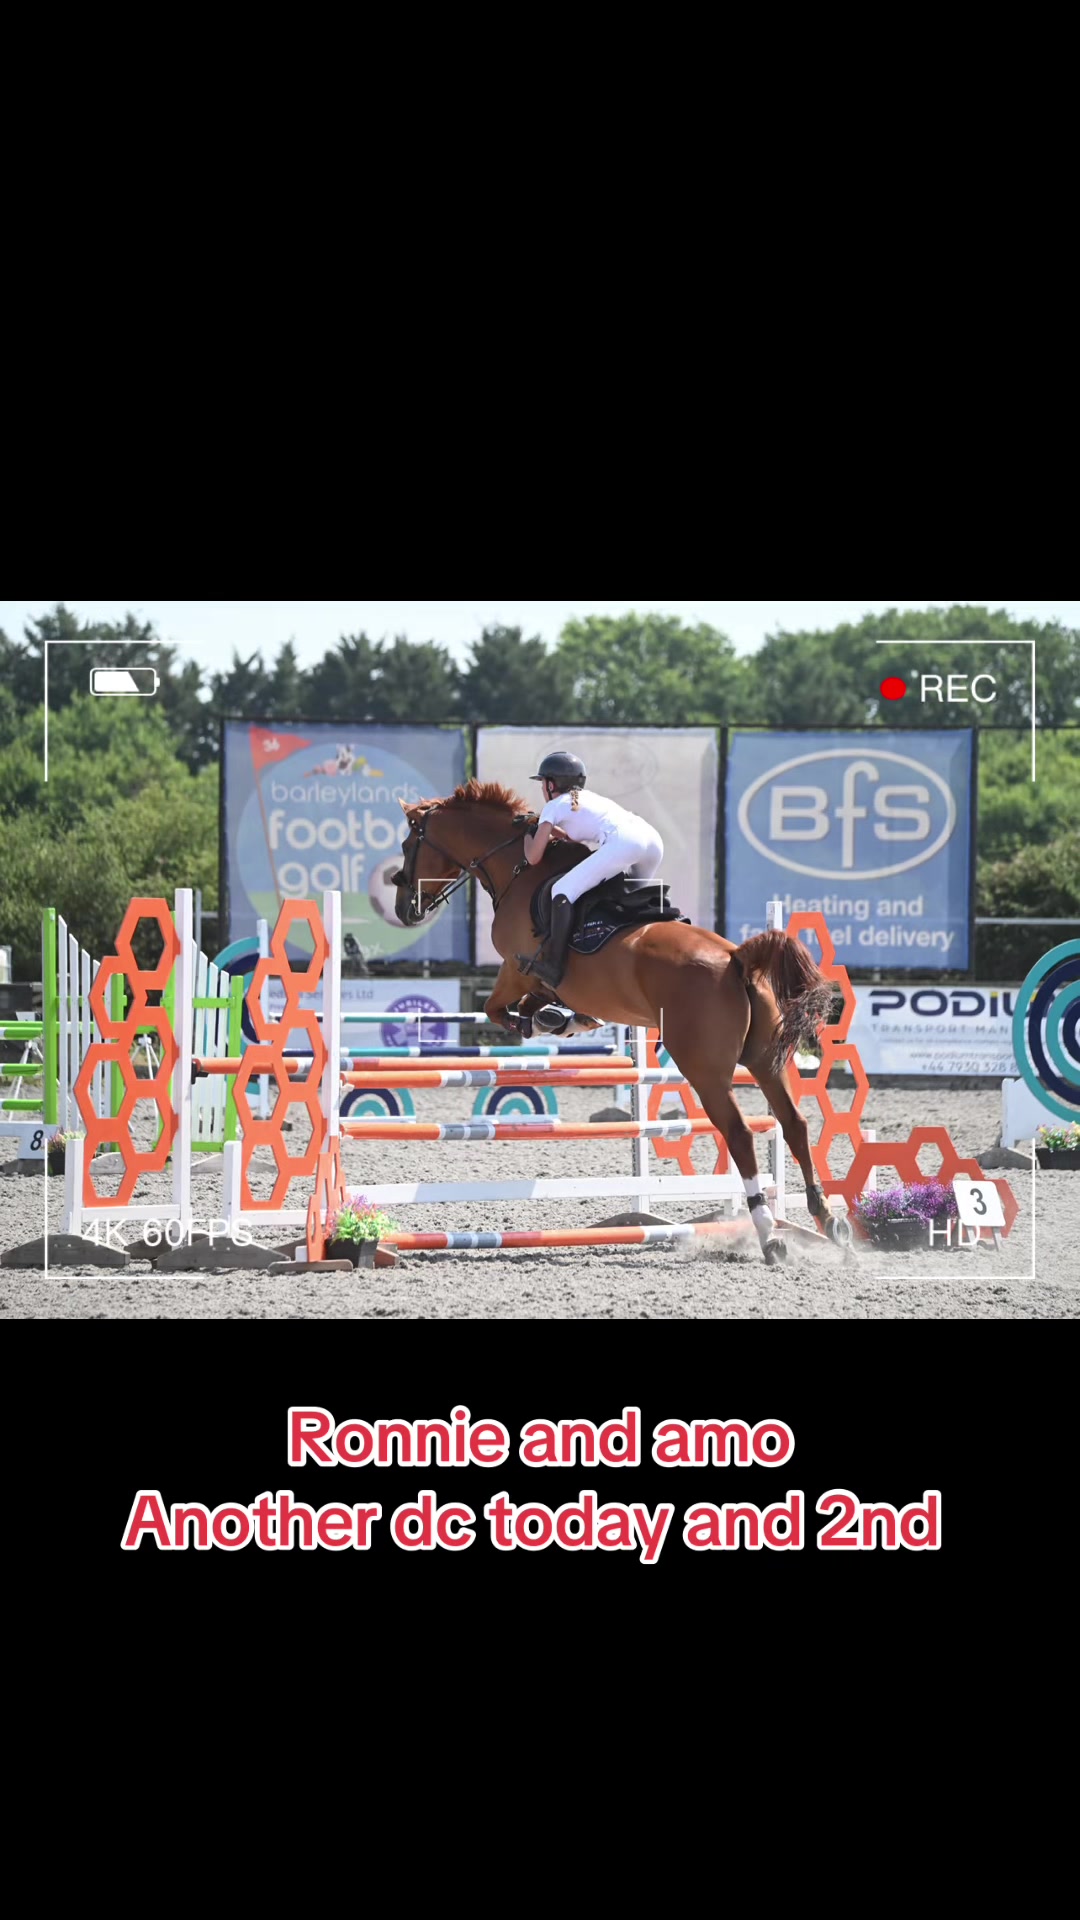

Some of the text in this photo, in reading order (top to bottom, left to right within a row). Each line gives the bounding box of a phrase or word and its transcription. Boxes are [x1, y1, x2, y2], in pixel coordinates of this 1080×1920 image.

[263, 738, 280, 752] 36
[271, 782, 419, 807] barleylands
[769, 760, 930, 869] BfS
[269, 809, 408, 850] footb
[278, 853, 366, 899] golf
[773, 894, 924, 920] Heating and
[858, 925, 955, 952] delivery
[355, 990, 374, 999] Ltd
[872, 1023, 966, 1034] TRANSPORT
[30, 1130, 44, 1151] 8
[970, 1188, 988, 1215] 3
